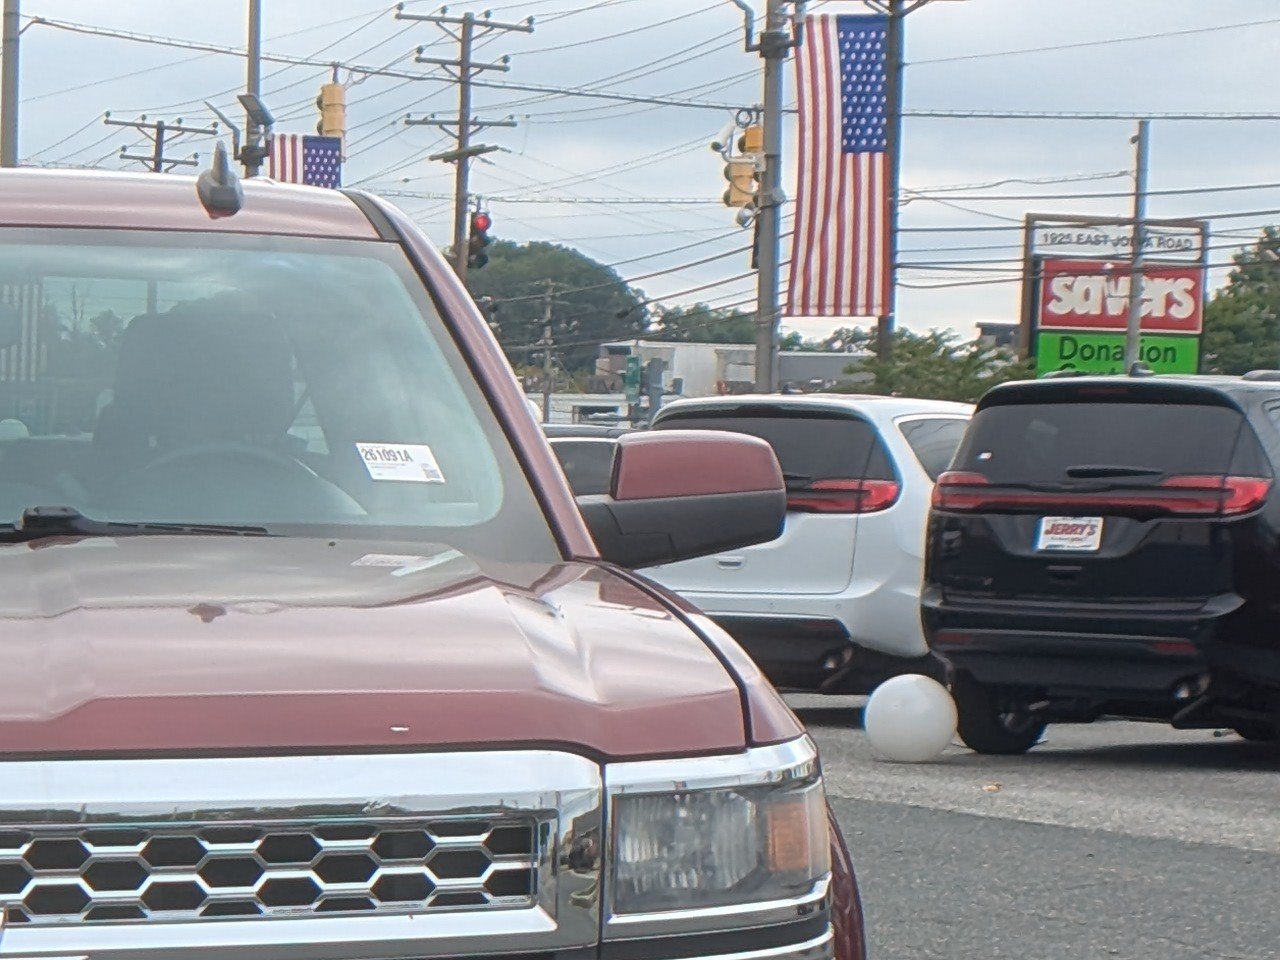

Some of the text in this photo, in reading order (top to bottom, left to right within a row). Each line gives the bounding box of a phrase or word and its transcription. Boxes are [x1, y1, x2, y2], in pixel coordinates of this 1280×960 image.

[1077, 233, 1110, 246] EAST
[1157, 236, 1193, 250] ROAD
[1059, 337, 1177, 363] Donaion
